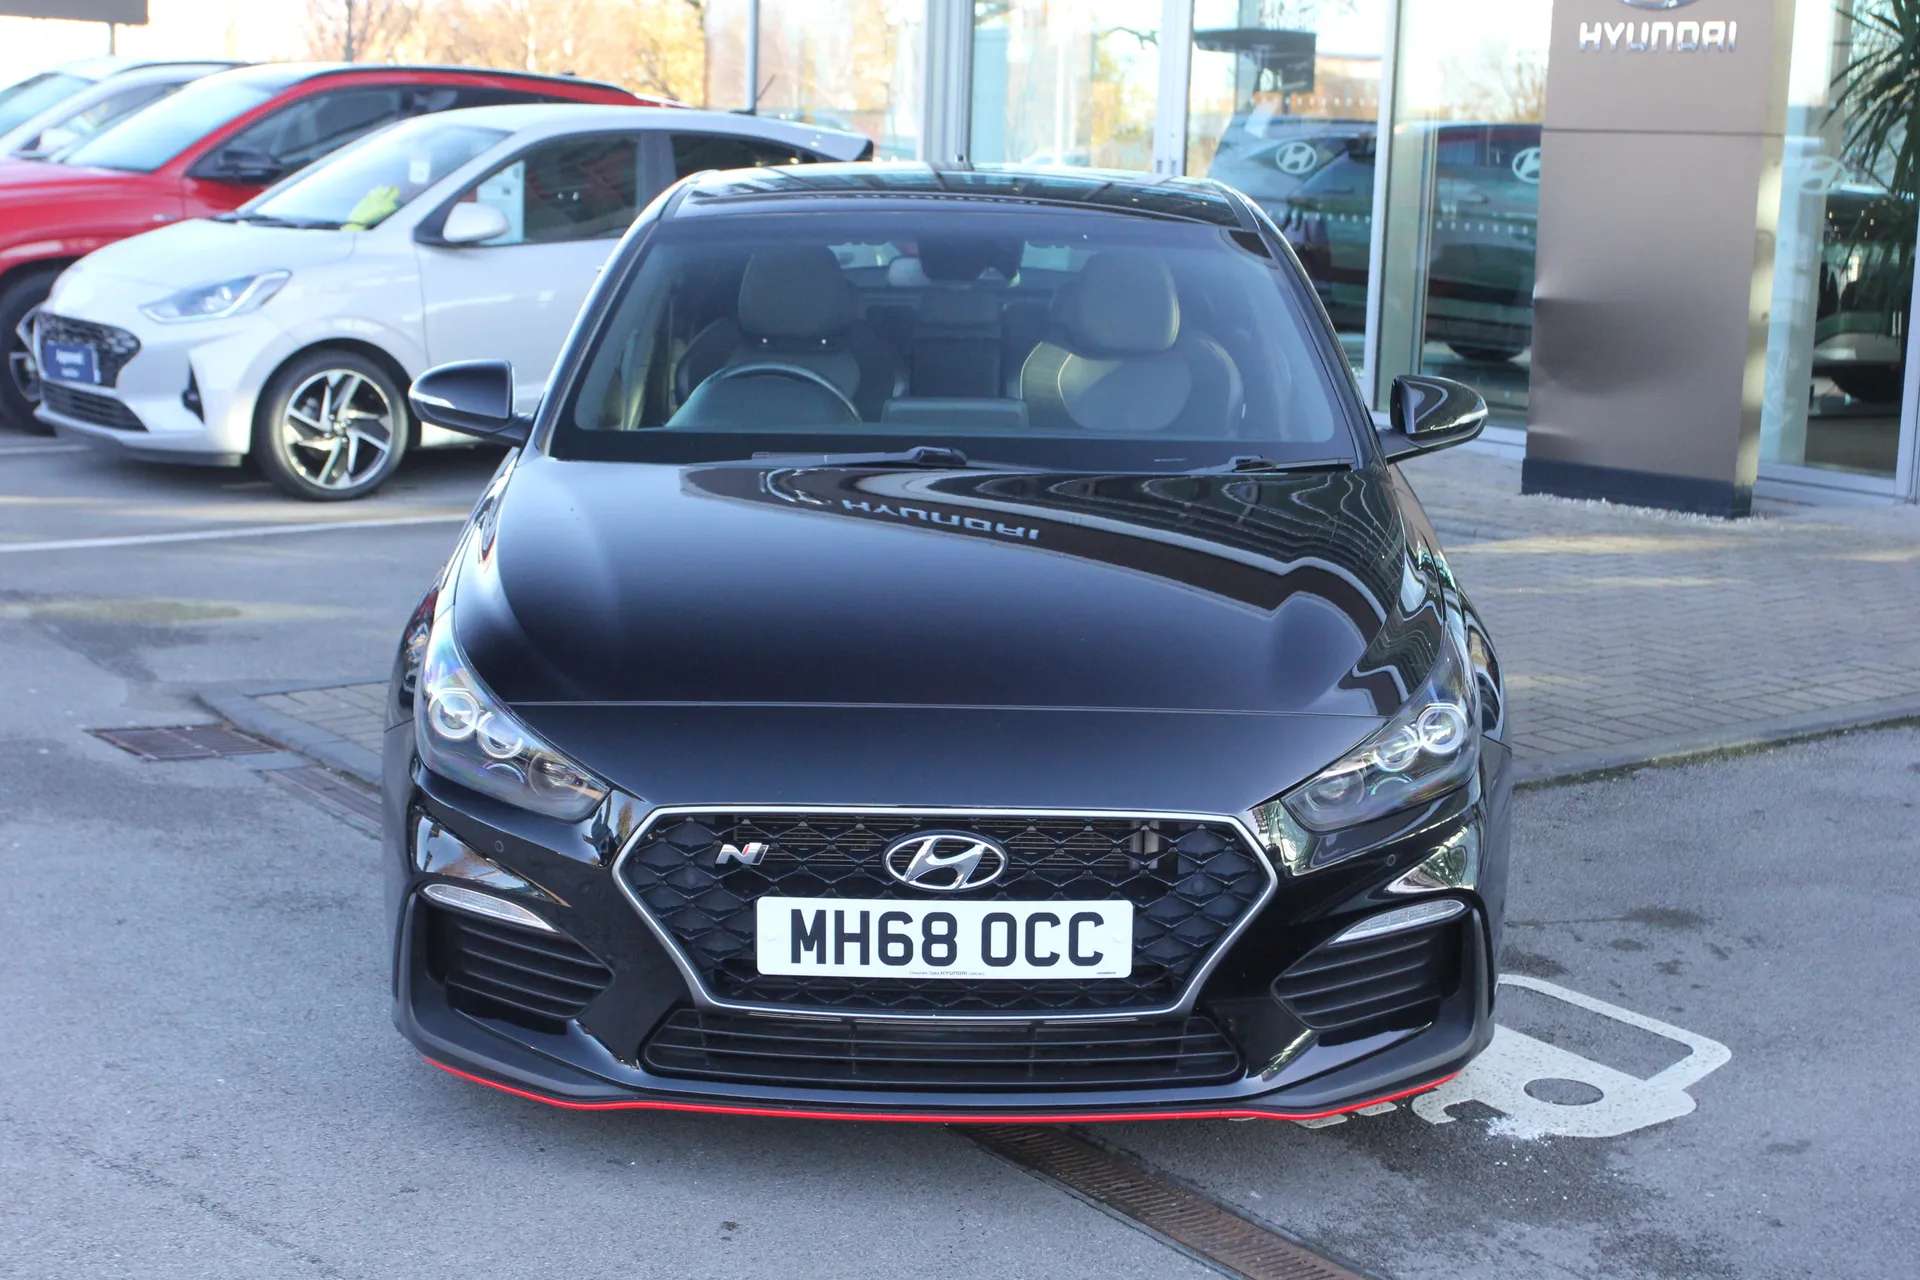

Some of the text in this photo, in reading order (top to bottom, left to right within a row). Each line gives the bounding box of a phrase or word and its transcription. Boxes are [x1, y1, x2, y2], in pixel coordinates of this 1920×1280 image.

[1579, 20, 1738, 51] HYUNDAI
[790, 908, 1105, 967] MH68 OCC
